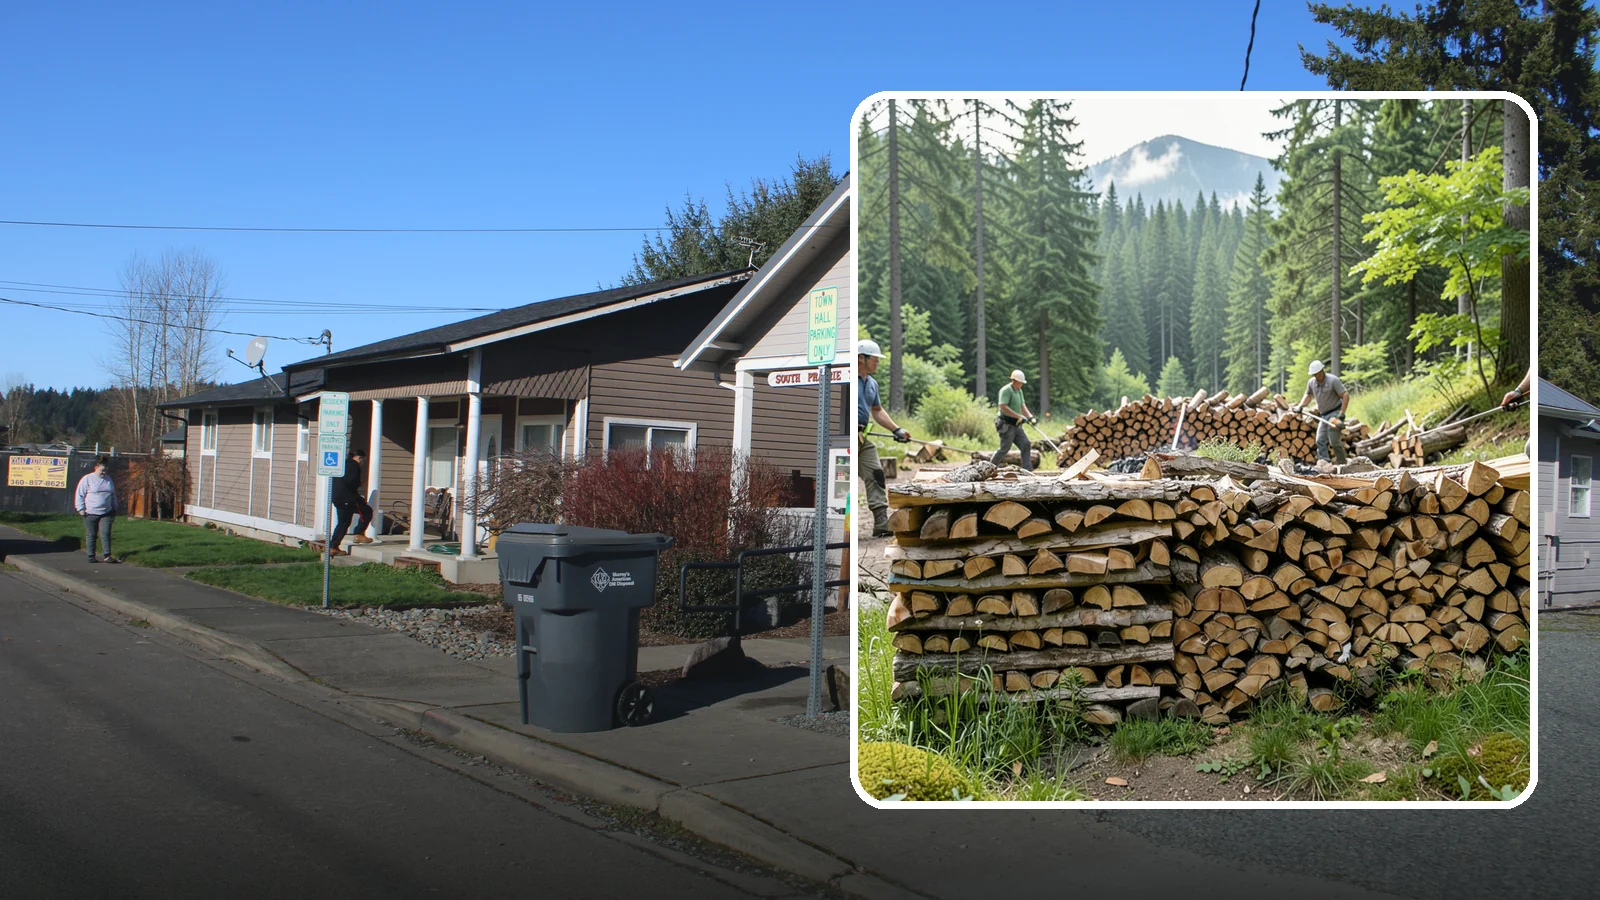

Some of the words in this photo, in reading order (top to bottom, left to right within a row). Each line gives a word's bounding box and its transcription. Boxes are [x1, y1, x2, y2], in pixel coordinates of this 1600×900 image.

[815, 295, 833, 308] TOWN
[814, 312, 831, 324] HALL
[809, 326, 836, 341] PARKING
[813, 344, 830, 357] ONLY
[775, 373, 801, 384] SOUTH
